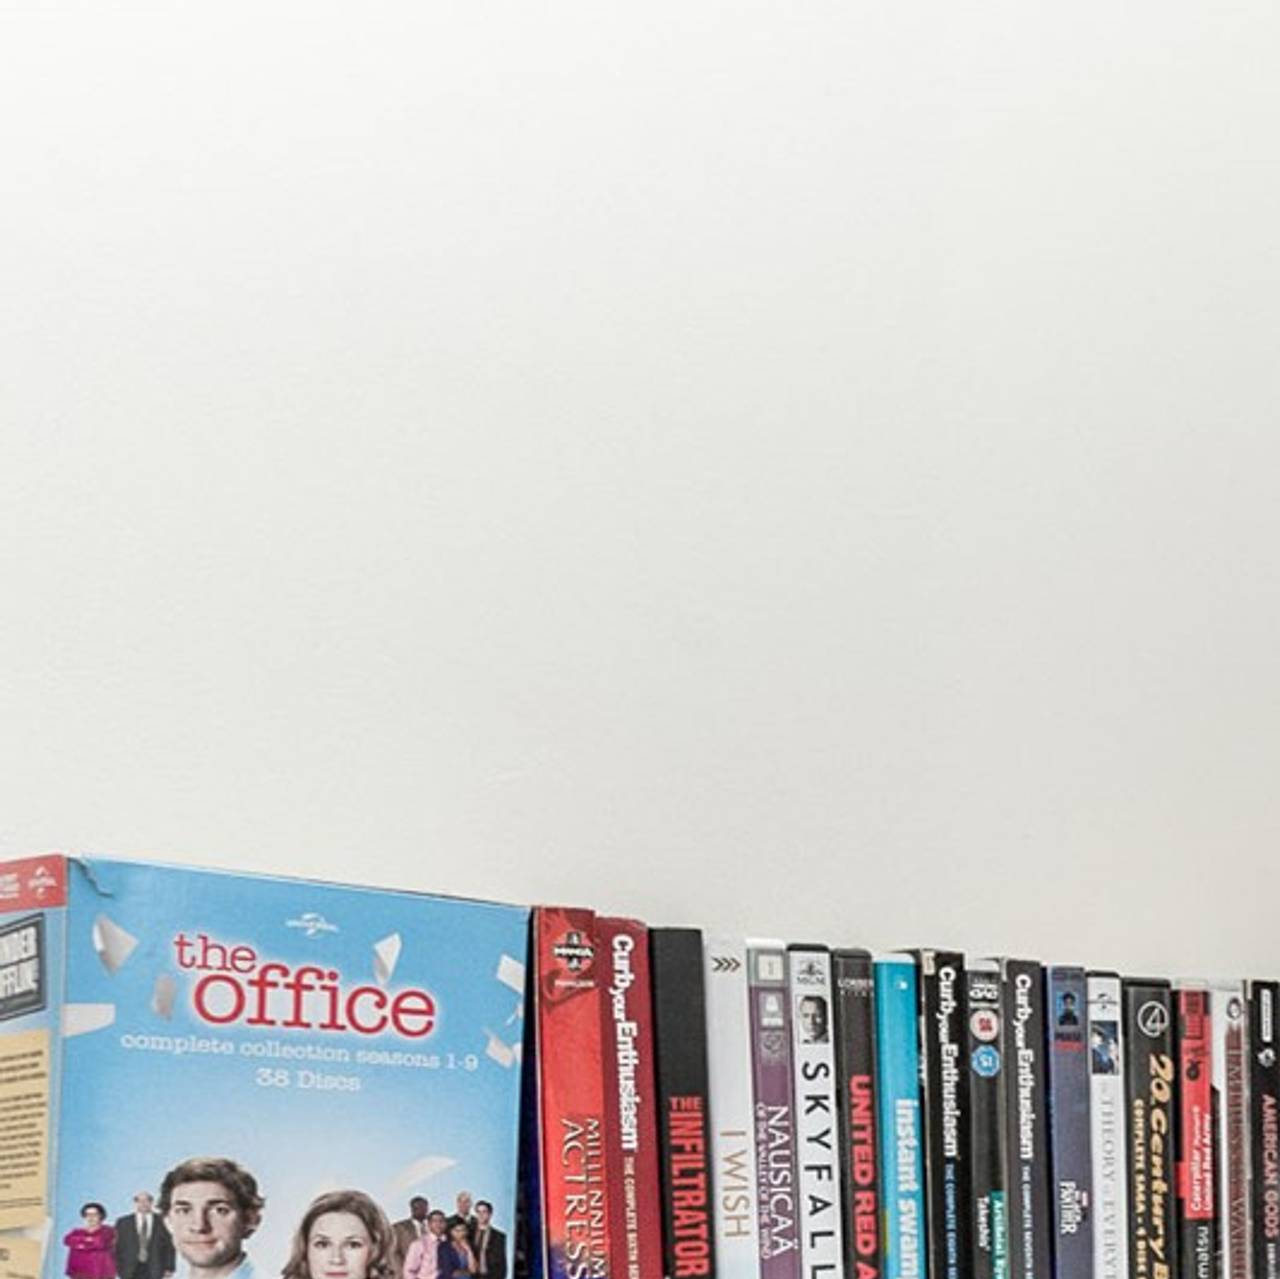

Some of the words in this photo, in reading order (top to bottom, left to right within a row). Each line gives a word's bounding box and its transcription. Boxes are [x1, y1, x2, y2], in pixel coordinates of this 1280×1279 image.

[173, 934, 258, 974] the
[611, 933, 637, 988] Curb
[938, 966, 957, 1014] Curb
[1015, 973, 1033, 1020] Curb
[121, 1033, 234, 1055] complete
[240, 1040, 350, 1063] collection
[356, 1050, 441, 1070] seasons
[445, 1053, 479, 1071] 1-9
[256, 1068, 290, 1088] 38
[297, 1070, 362, 1091] Discs
[615, 1020, 639, 1150] Enthusiasm
[851, 1075, 874, 1184] UNITED
[941, 1044, 960, 1157] Enthusiasm
[1017, 1048, 1036, 1159] Enthusiasm
[1133, 1099, 1146, 1170] COMPLETE
[623, 1156, 634, 1175] THE
[894, 1099, 919, 1192] instant
[1101, 1098, 1116, 1182] THEORY
[1261, 1095, 1279, 1187] AMERICAN
[624, 1178, 637, 1230] COMPLETE
[668, 1111, 710, 1278] INFILTRATOR
[722, 1151, 750, 1238] WISH
[767, 1105, 798, 1257] NAUSICAÄ
[1134, 1174, 1147, 1212] SAGA
[1144, 1108, 1169, 1260] Century
[1263, 1190, 1280, 1238] GODS
[854, 1191, 877, 1255] RED
